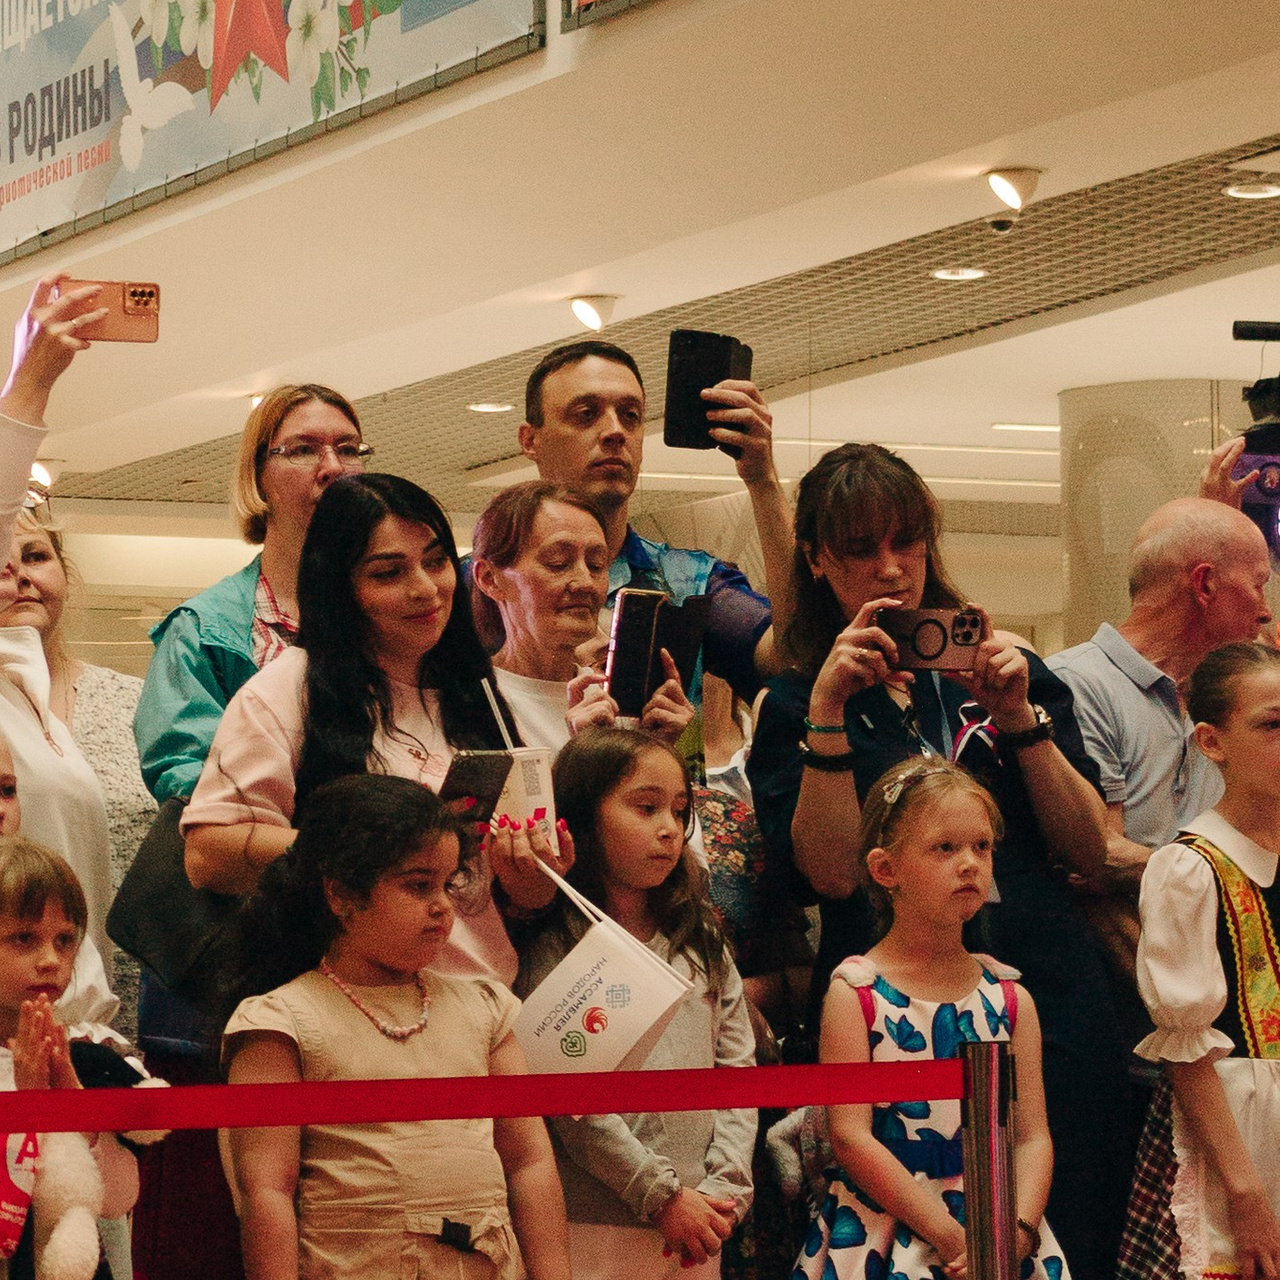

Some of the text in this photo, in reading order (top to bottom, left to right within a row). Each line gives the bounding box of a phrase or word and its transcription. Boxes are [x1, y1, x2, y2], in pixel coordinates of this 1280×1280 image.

[8, 58, 111, 165] РОДИНЫ
[76, 140, 112, 175] песни
[533, 957, 608, 1038] НАРОДОВ РОССИИ
[553, 977, 604, 1032] АССАМБЛЕЯ
